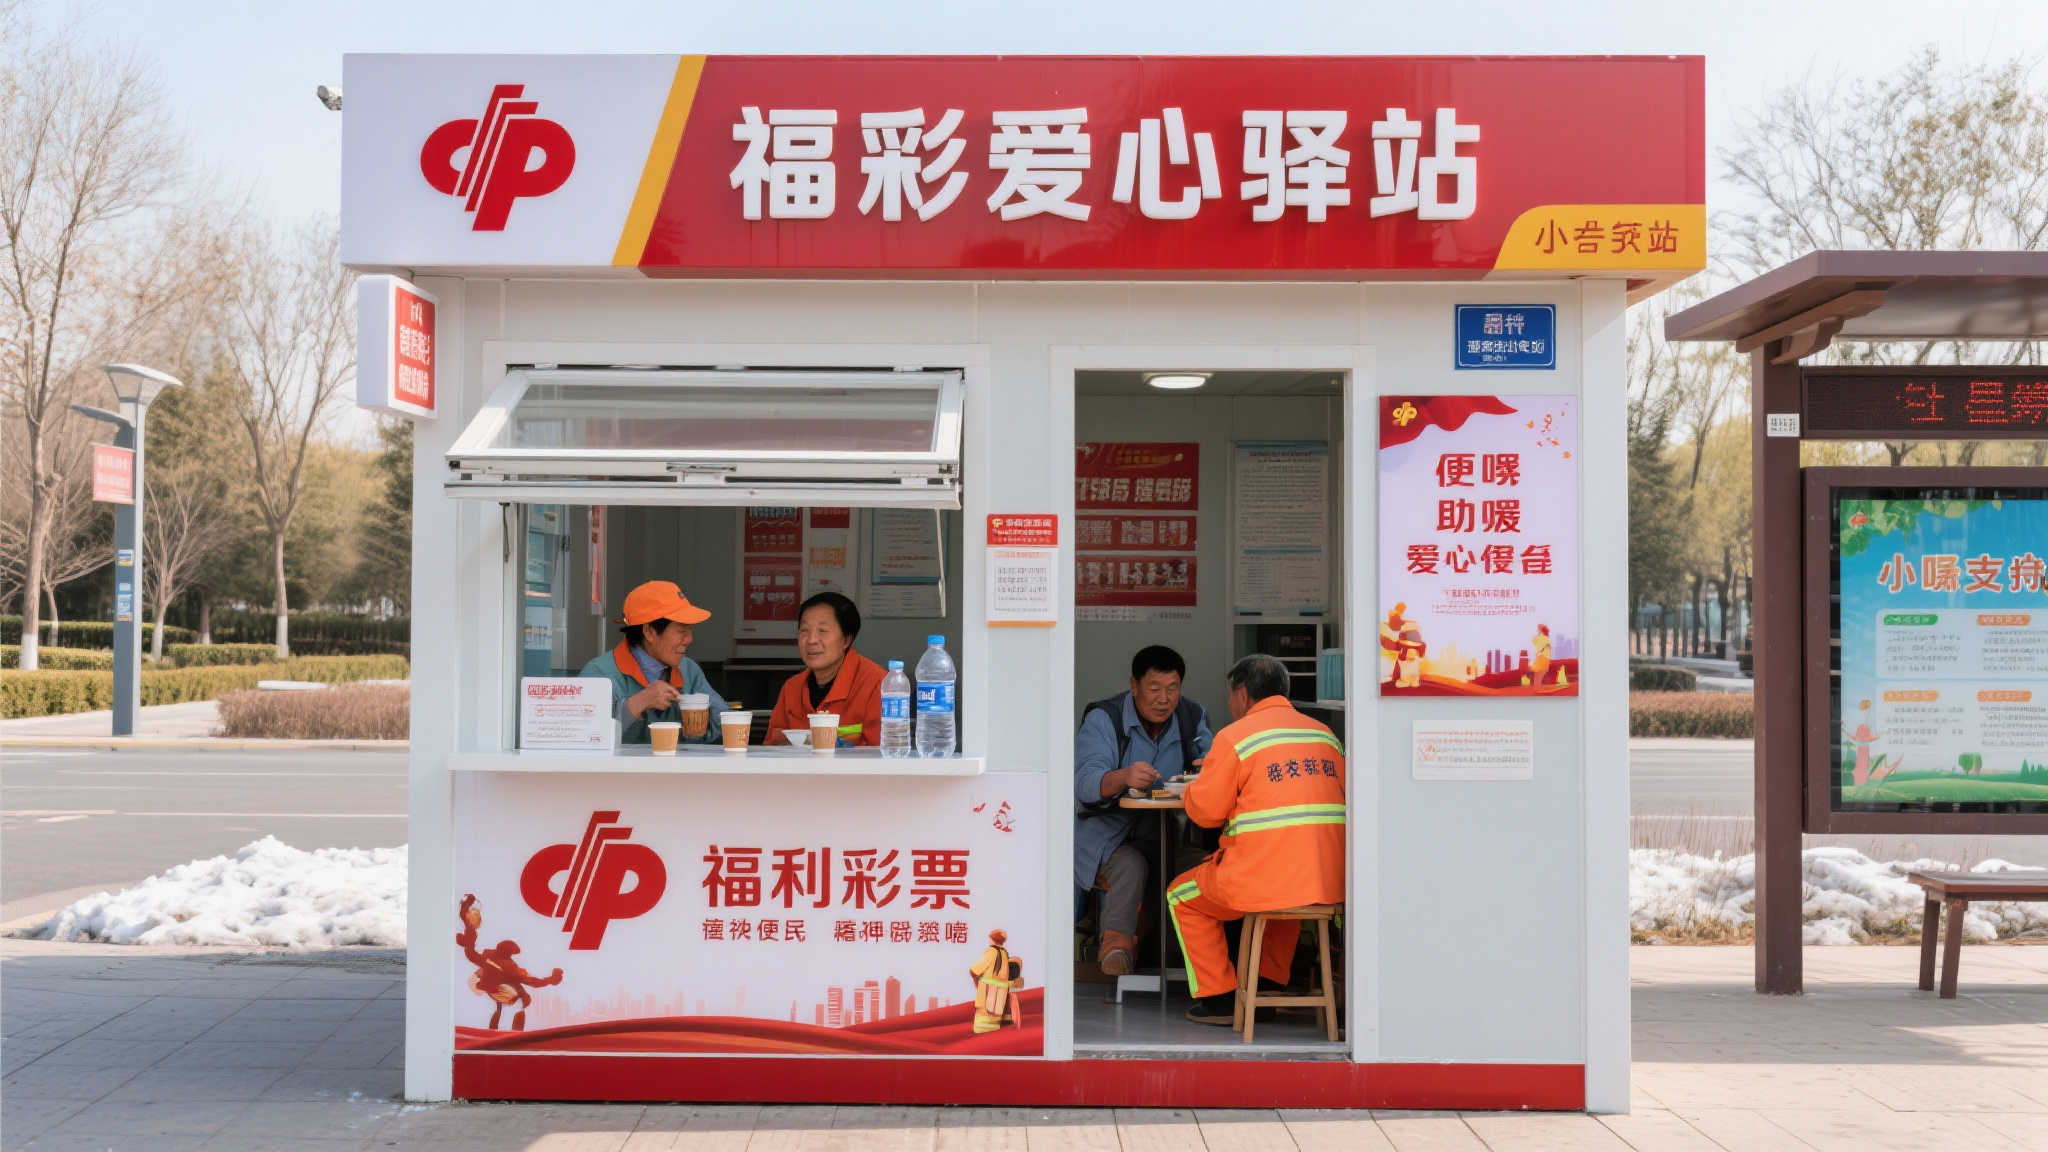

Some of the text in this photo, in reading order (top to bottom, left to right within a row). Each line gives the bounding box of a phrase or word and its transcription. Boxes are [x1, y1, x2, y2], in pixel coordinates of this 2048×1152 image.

[730, 106, 1480, 222] 福彩爱心驿站
[702, 845, 970, 910] 福利彩票
